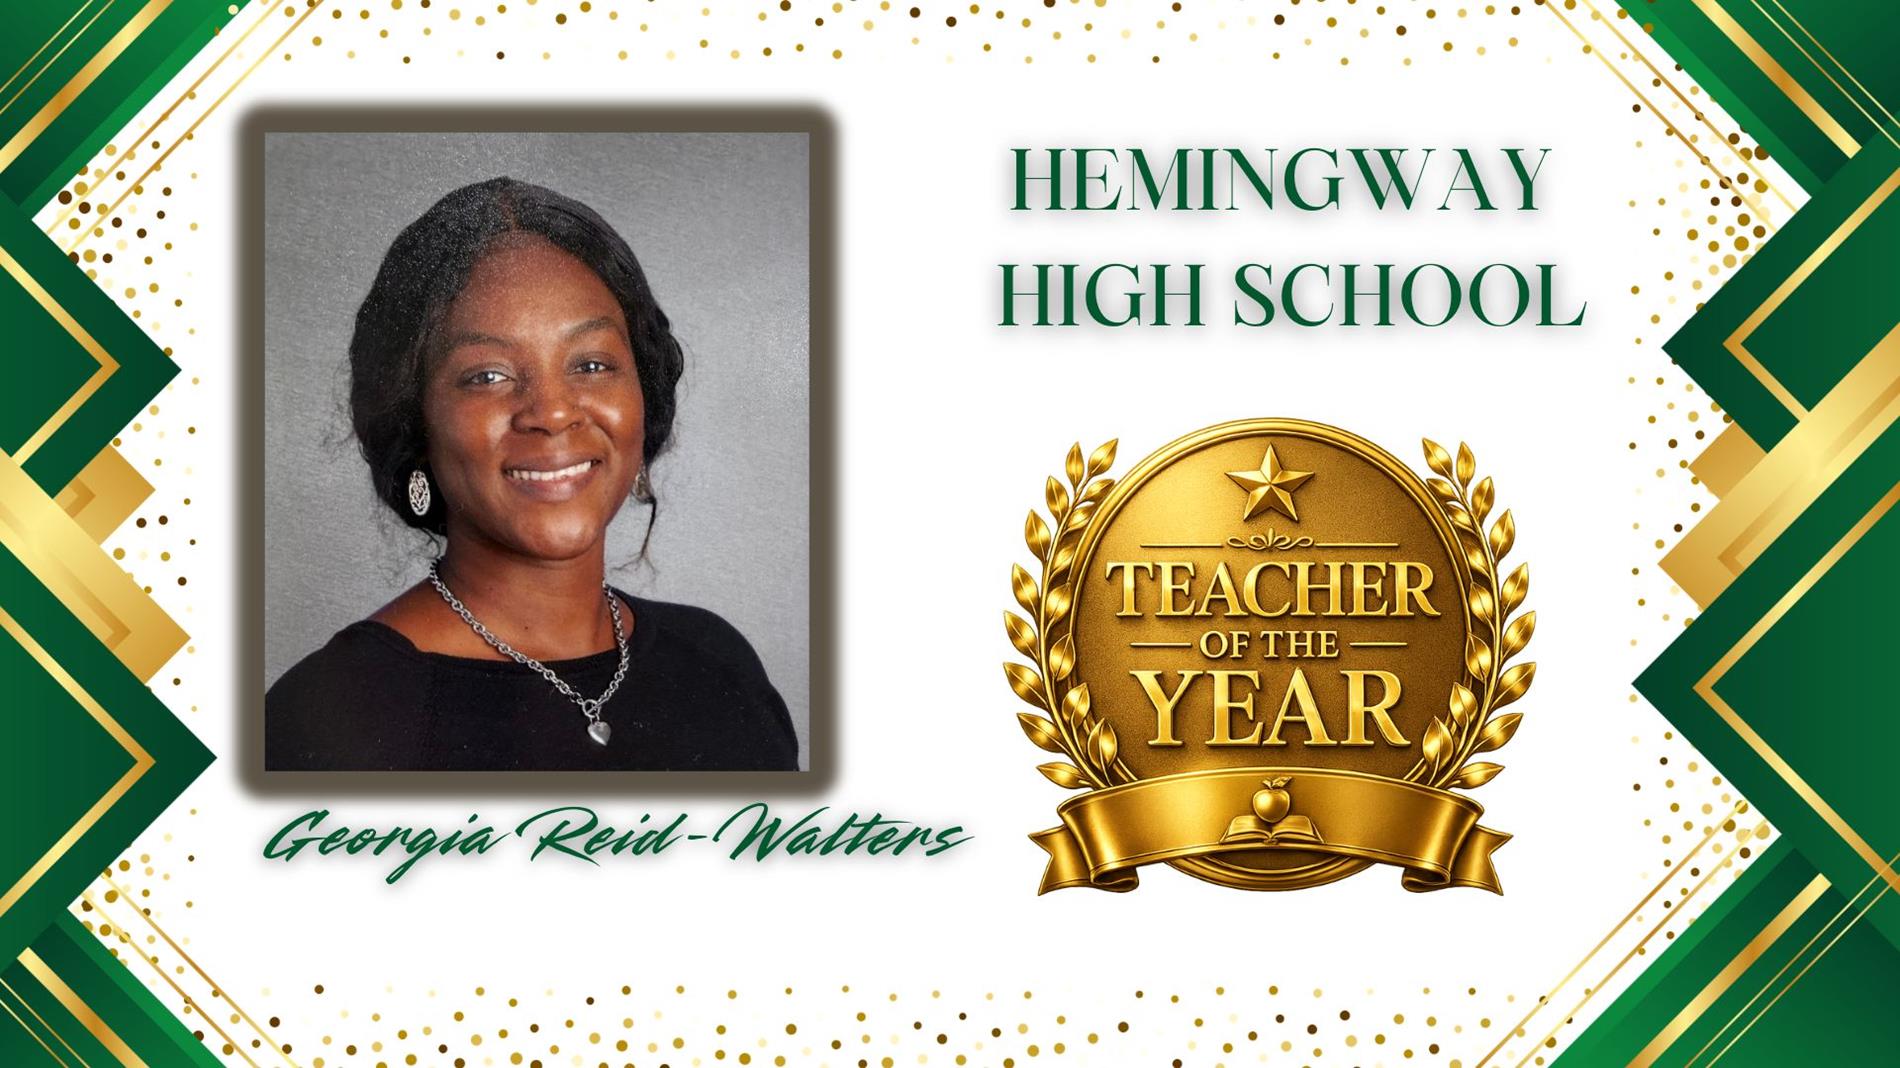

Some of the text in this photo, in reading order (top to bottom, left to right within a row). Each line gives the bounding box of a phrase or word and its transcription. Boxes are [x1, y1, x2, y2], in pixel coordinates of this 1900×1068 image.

[1010, 147, 1552, 212] HEMINGWAY
[998, 262, 1587, 328] HIGH SCHOOL
[1105, 561, 1441, 617] TEACHER
[1199, 631, 1340, 659] OF THE
[1129, 668, 1411, 747] YEAR
[262, 802, 975, 885] Georgia Reid-Walters
